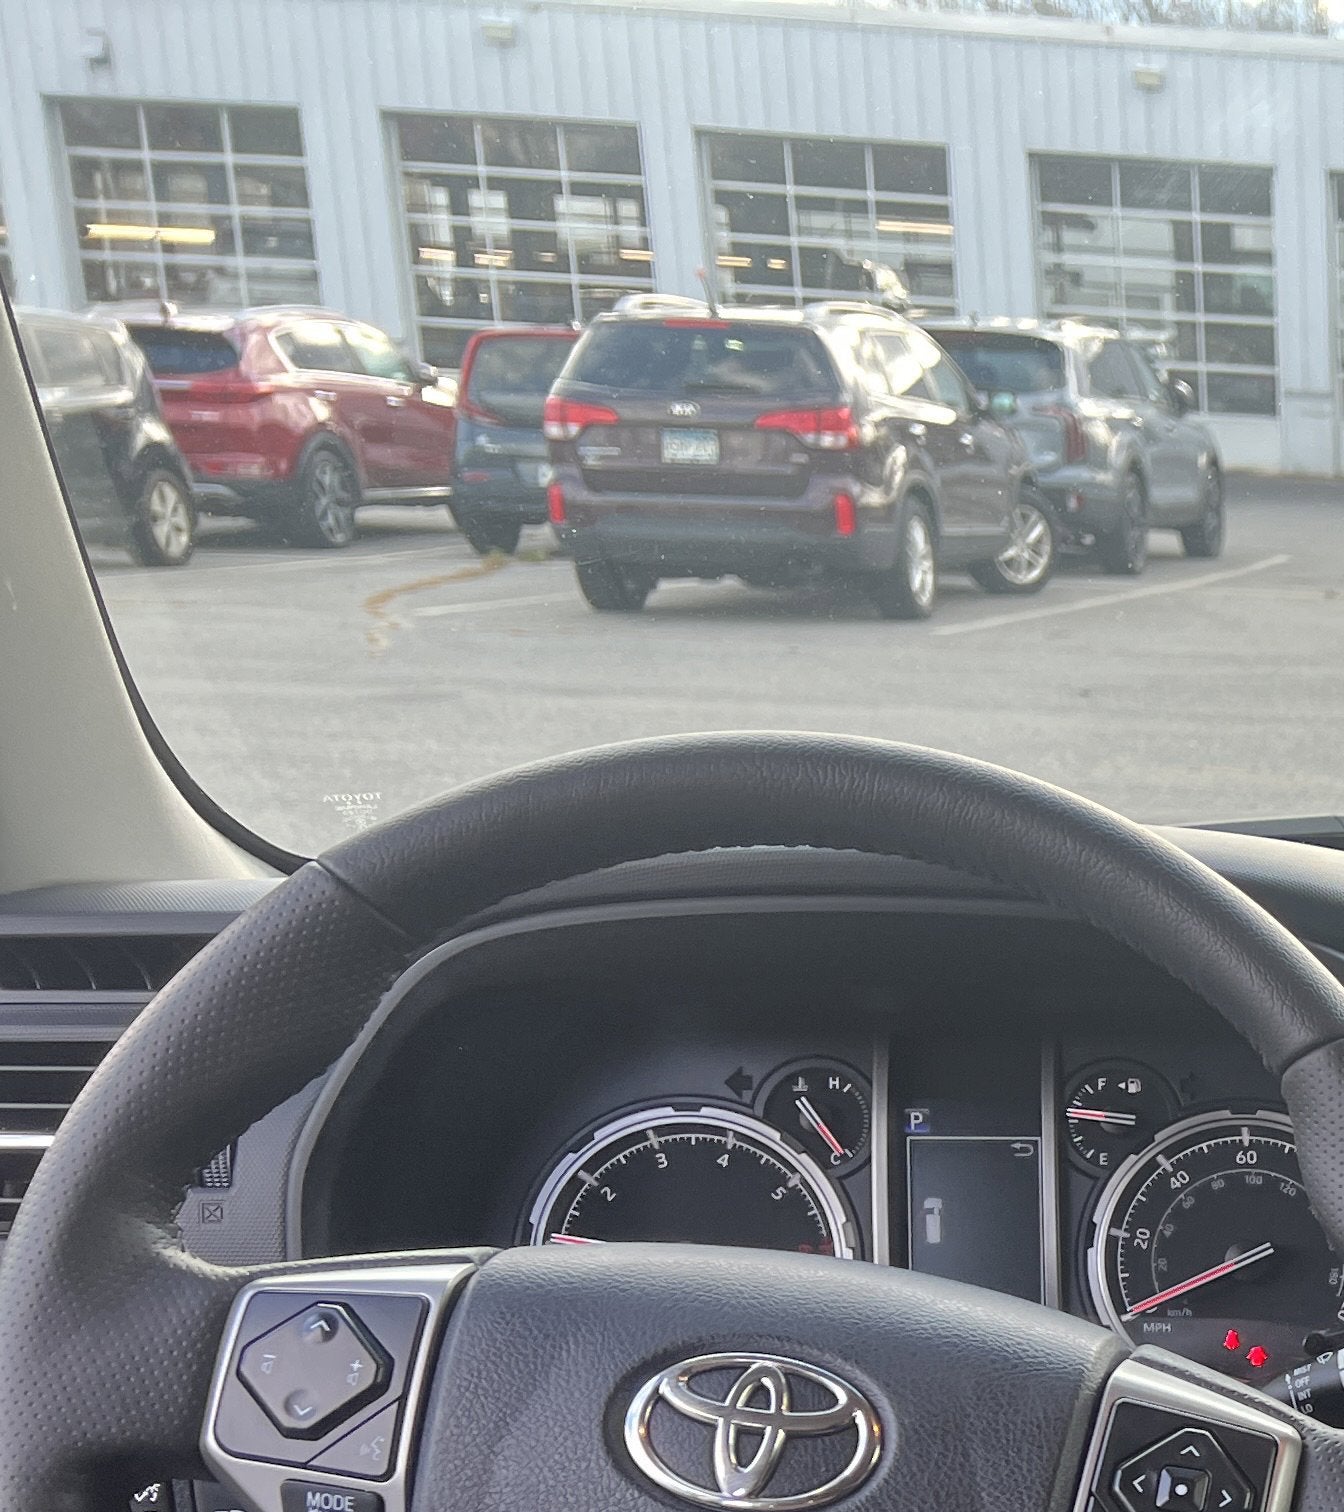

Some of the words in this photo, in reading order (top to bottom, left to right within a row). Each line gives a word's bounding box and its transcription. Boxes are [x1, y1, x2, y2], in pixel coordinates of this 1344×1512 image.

[828, 1077, 839, 1089] H
[1097, 1078, 1107, 1090] F
[910, 1111, 923, 1131] P
[655, 1153, 669, 1169] 3
[716, 1153, 729, 1168] 4
[830, 1152, 842, 1166] C
[1099, 1153, 1108, 1166] E
[1236, 1150, 1257, 1165] 60
[1169, 1170, 1190, 1191] 40
[601, 1186, 617, 1201] 2
[771, 1187, 787, 1200] 5
[1133, 1228, 1151, 1250] 20
[1143, 1322, 1172, 1333] MPH
[1295, 1376, 1310, 1388] OFF
[306, 1491, 355, 1512] MODE
